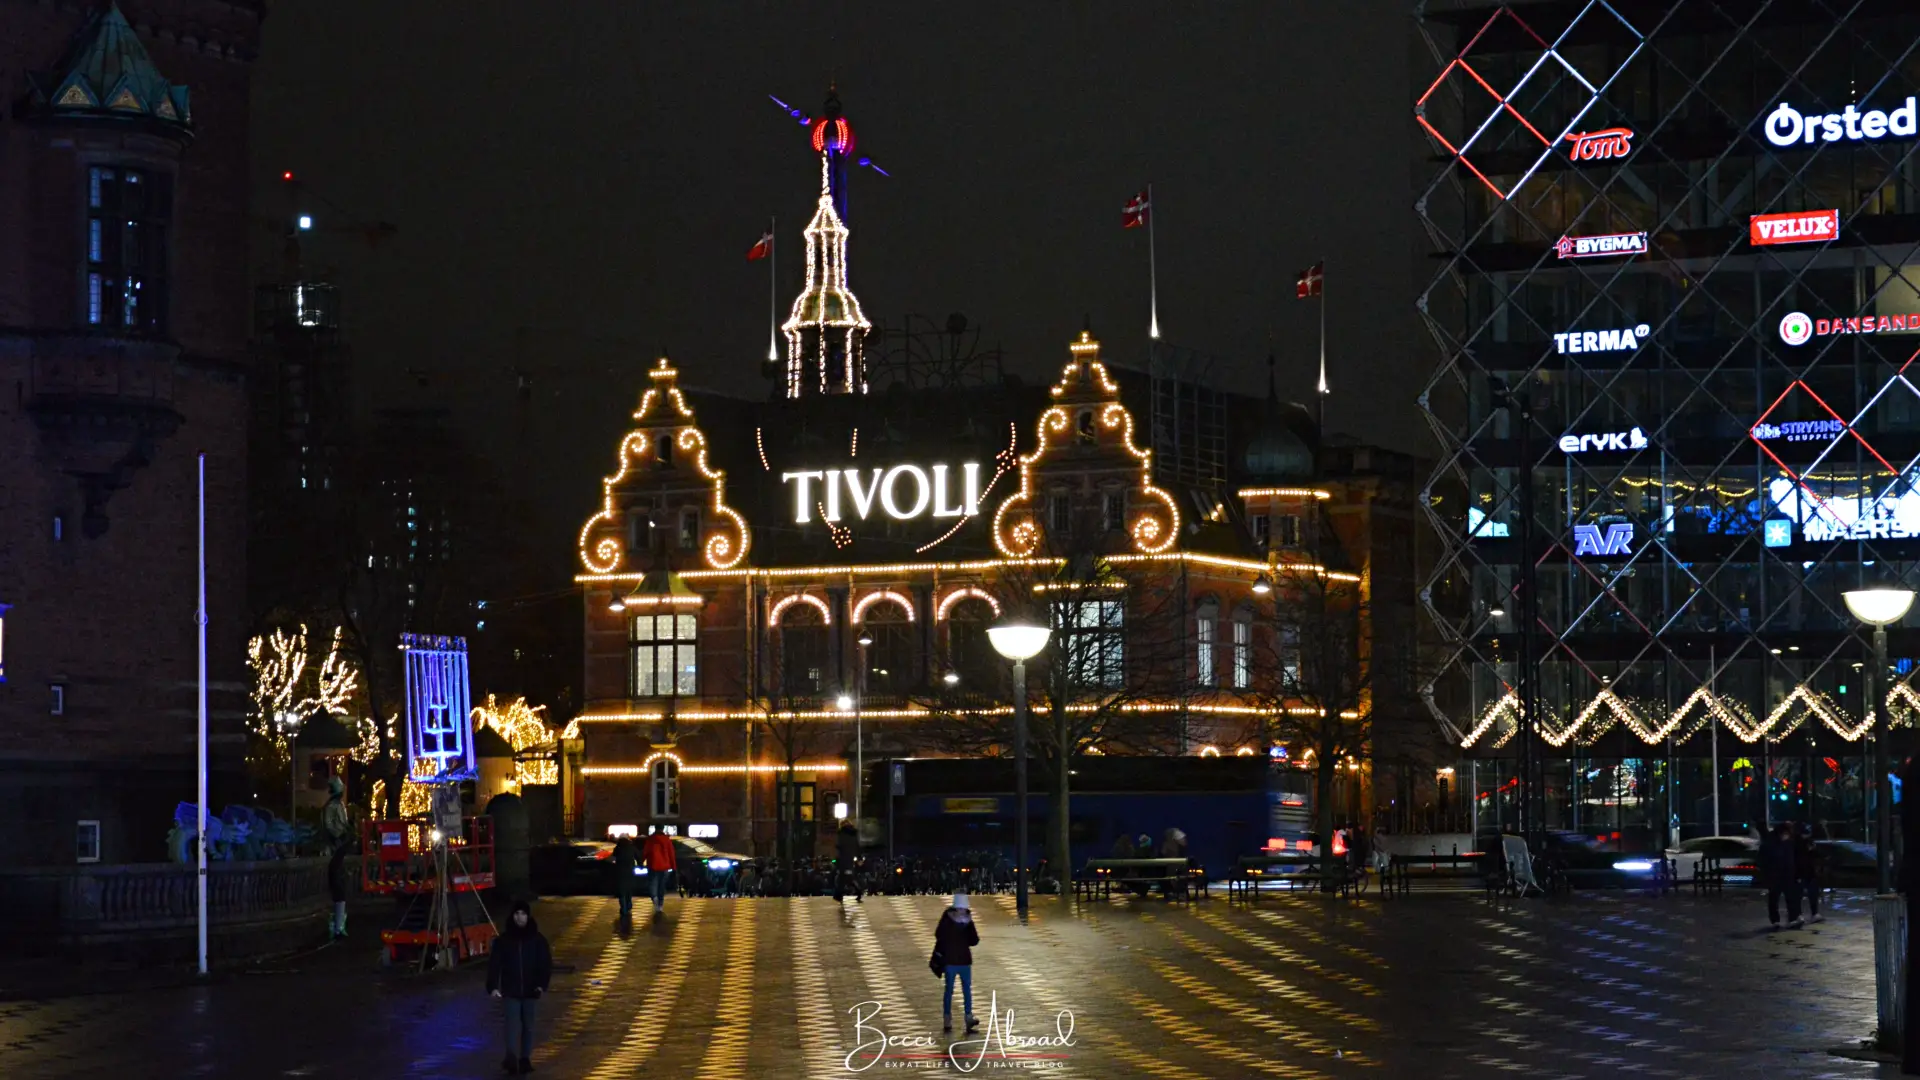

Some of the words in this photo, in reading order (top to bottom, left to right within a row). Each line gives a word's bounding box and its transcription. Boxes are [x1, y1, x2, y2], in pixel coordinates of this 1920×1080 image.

[1565, 127, 1634, 161] Toms
[1756, 216, 1831, 239] VELUX
[1576, 235, 1642, 254] BYGMA
[1815, 313, 1920, 336] DANSAND
[1553, 328, 1638, 354] TERMA
[1780, 420, 1843, 435] STRYHNS
[1787, 433, 1836, 442] GRUPPEN
[782, 463, 980, 523] TIVOLI
[1573, 523, 1634, 556] AVK
